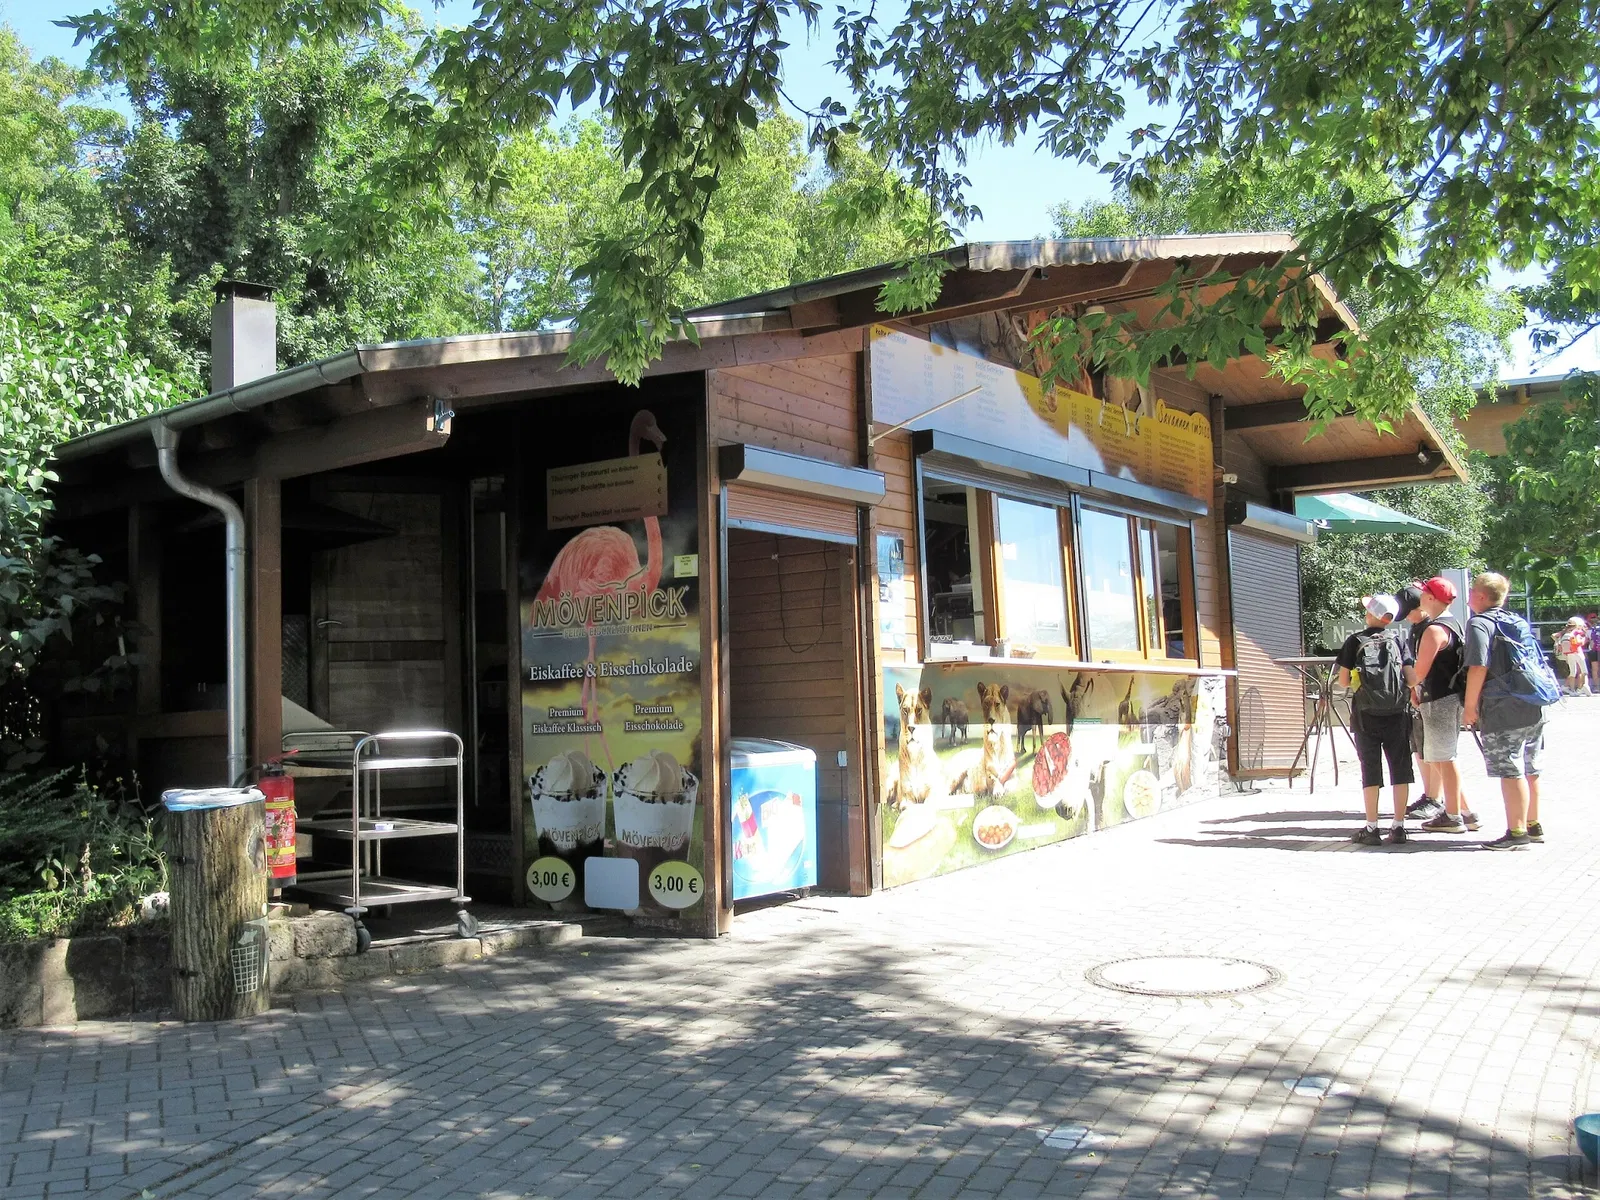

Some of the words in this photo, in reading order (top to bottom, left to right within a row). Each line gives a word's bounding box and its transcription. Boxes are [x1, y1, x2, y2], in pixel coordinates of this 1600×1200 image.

[580, 468, 610, 478] Bratwurst
[533, 584, 688, 627] MÖVENPICK
[563, 628, 586, 639] FEINE
[530, 663, 583, 680] Eiskaffee
[586, 662, 597, 678] &
[600, 656, 693, 677] Eisschokolade
[549, 708, 584, 718] Premium
[635, 704, 673, 714] Premium
[533, 723, 565, 733] Eiskaffee
[567, 721, 602, 732] Klassisch
[625, 720, 683, 731] Eisschokolade
[542, 822, 601, 842] MÖVENPICK
[622, 829, 686, 848] MÖVENPICK
[532, 871, 557, 888] 3,00
[562, 872, 570, 887] €
[654, 874, 683, 893] 3,00
[688, 878, 698, 893] €
